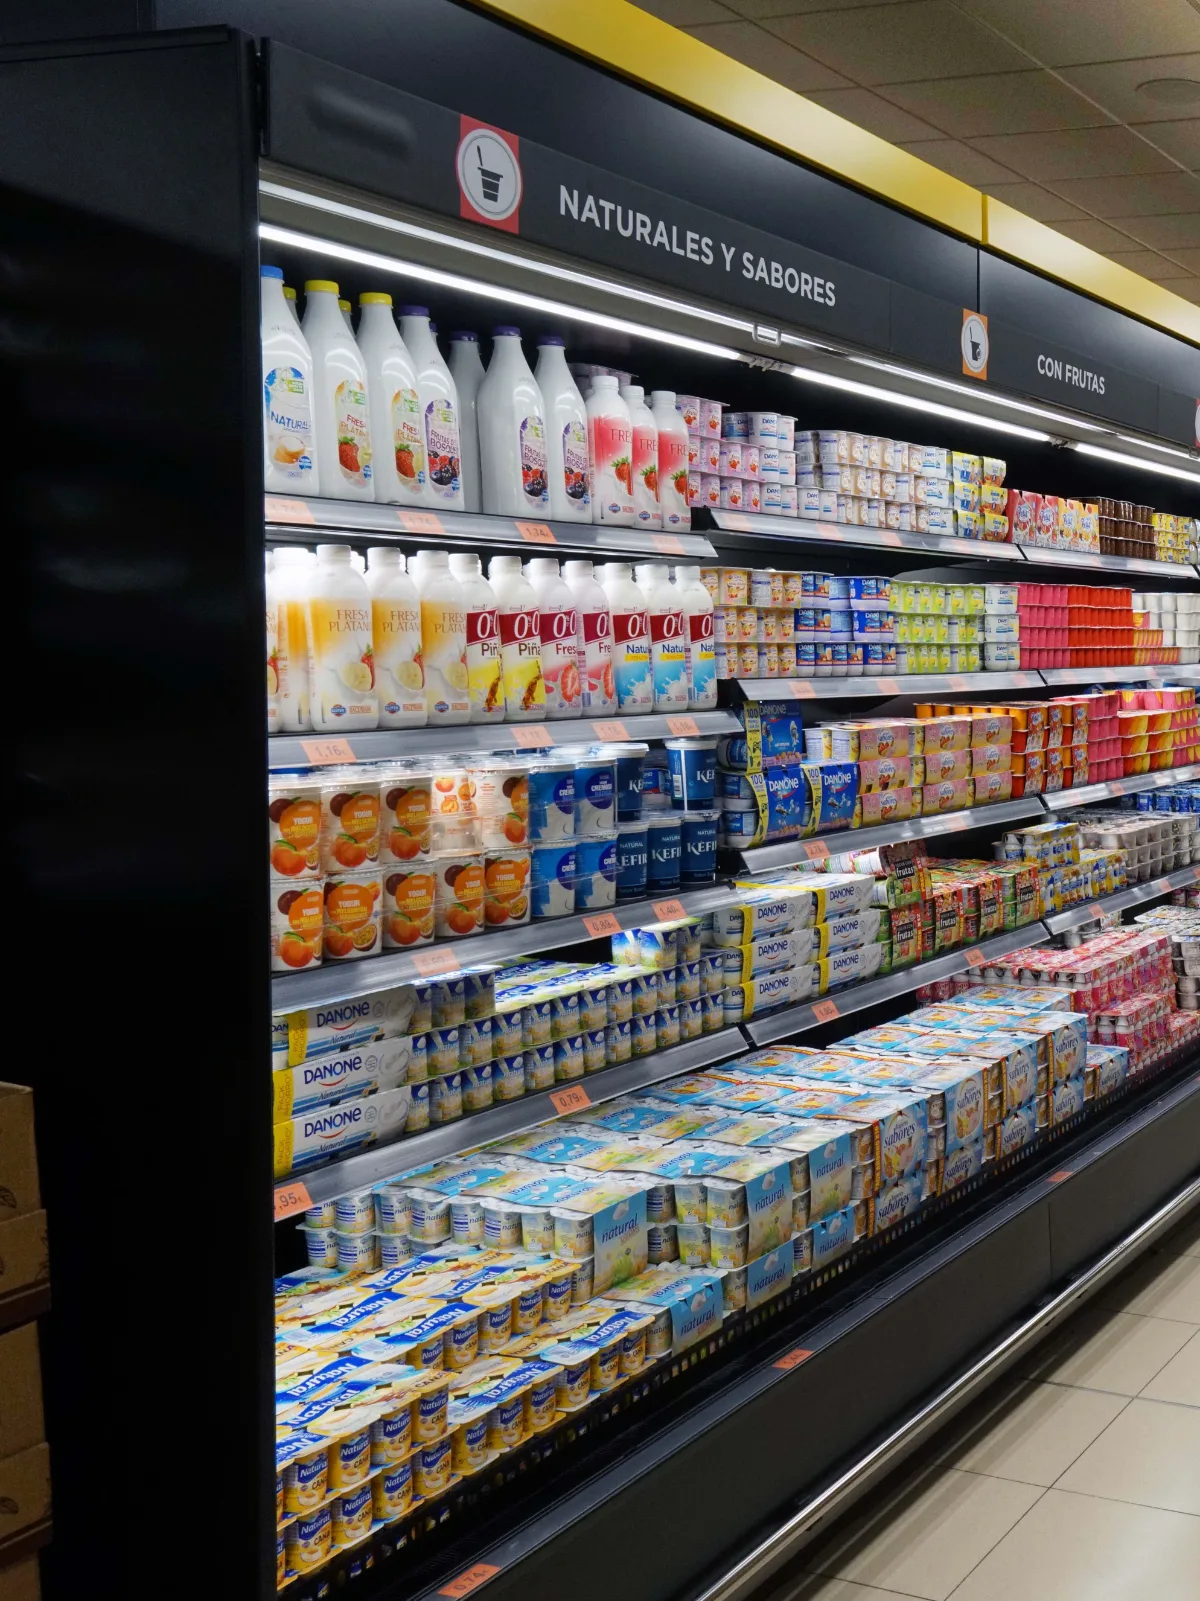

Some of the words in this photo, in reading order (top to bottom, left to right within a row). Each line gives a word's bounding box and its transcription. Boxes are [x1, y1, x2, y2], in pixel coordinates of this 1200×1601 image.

[559, 183, 714, 265] NATURALES
[720, 242, 736, 272] Y
[742, 251, 836, 307] SABORES
[1037, 354, 1063, 381] CON
[1065, 364, 1106, 396] FRUTAS
[768, 777, 799, 792] DANONE
[824, 772, 852, 786] DANONE
[896, 866, 914, 878] frutas
[829, 885, 855, 901] DANONE
[757, 902, 788, 920] DANONE
[940, 916, 956, 928] frutas
[832, 919, 859, 936] DANONE
[897, 929, 914, 942] frutas
[758, 939, 788, 957] DANONE
[833, 953, 859, 971] DANONE
[759, 976, 789, 995] DANONE
[316, 1001, 370, 1028] DANONE
[1055, 1036, 1079, 1053] sabores
[303, 1055, 362, 1085] DANONE
[317, 1084, 348, 1102] Natural
[956, 1088, 982, 1112] sabores
[304, 1107, 362, 1138] DANONE
[319, 1136, 349, 1153] Natural
[883, 1122, 915, 1149] sabores
[815, 1156, 844, 1179] natural
[945, 1156, 972, 1178] sabores
[755, 1183, 785, 1213] natural
[877, 1192, 911, 1220] sabores
[601, 1214, 638, 1244] natural
[819, 1230, 848, 1255] natural
[753, 1263, 786, 1293] natural
[330, 1296, 394, 1328] Natural
[680, 1303, 716, 1337] natural
[405, 1308, 466, 1340] Natural
[587, 1313, 635, 1345] Natural
[287, 1360, 358, 1397] Natural
[483, 1369, 540, 1399] Natural
[344, 1491, 372, 1512] Natural
[301, 1512, 330, 1535] Natural
[313, 1531, 330, 1546] CANA
